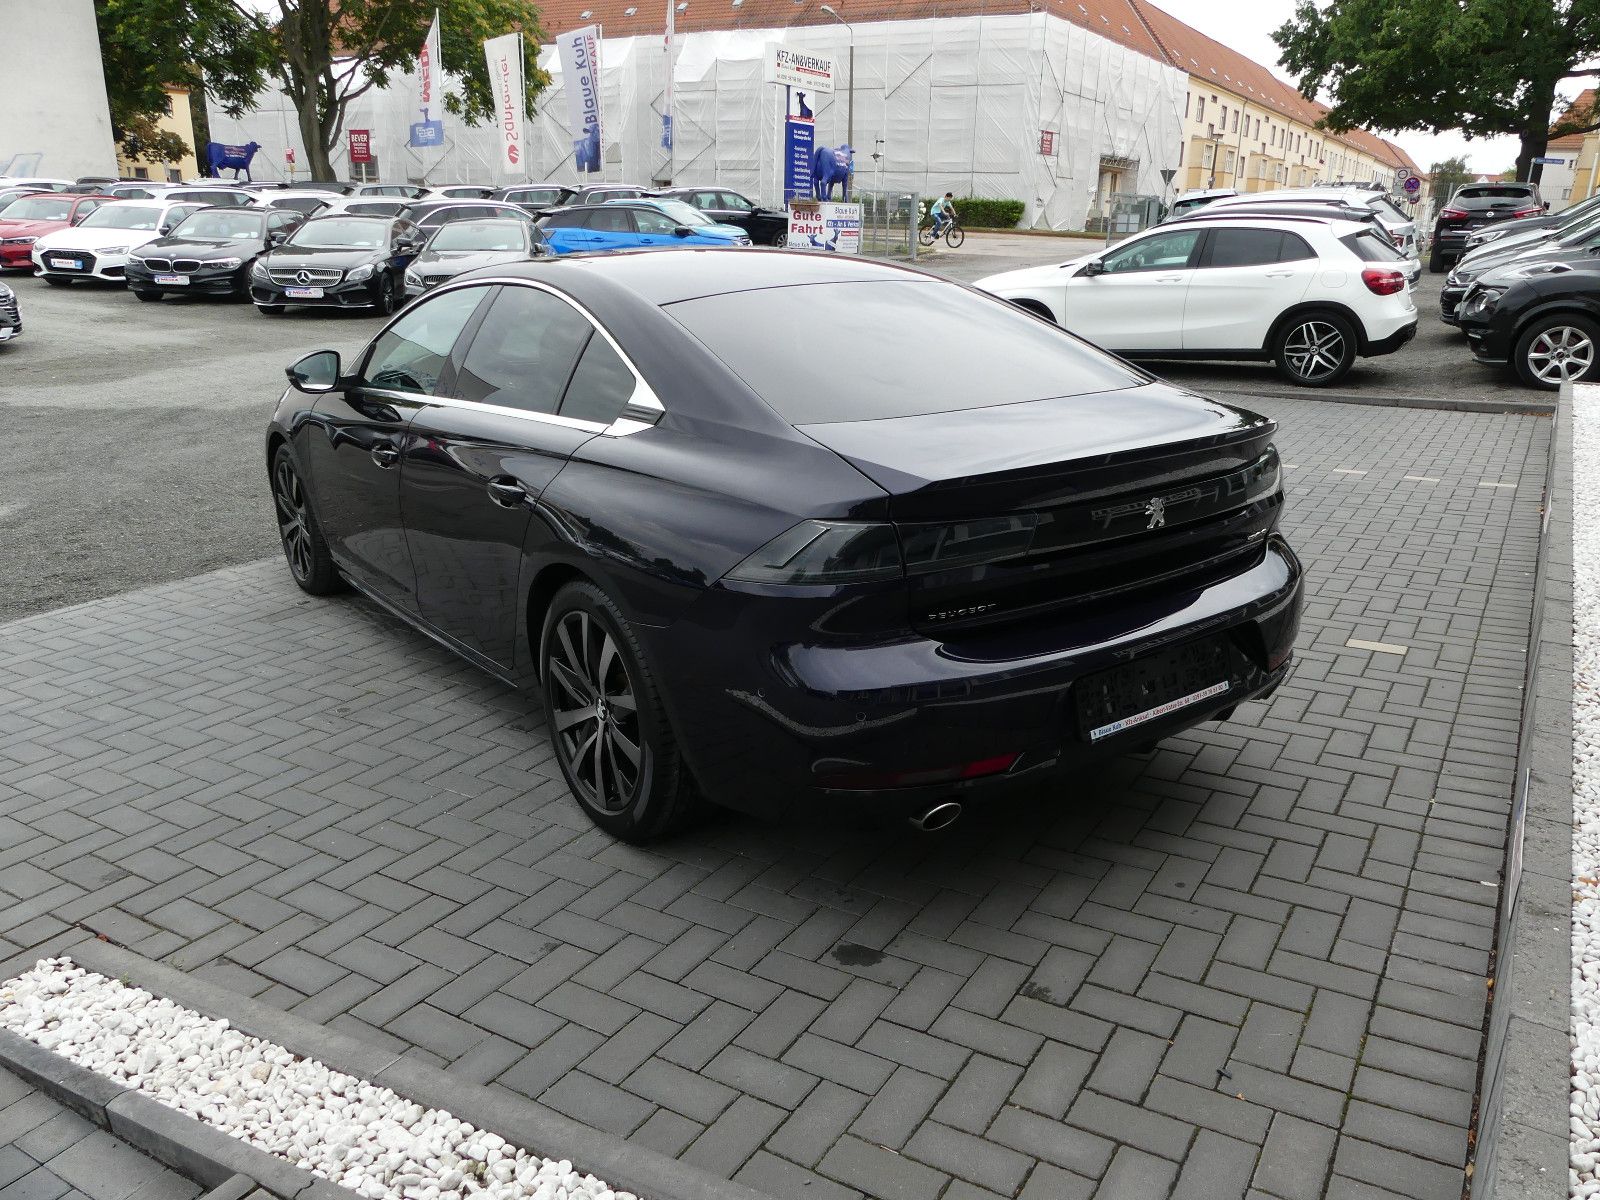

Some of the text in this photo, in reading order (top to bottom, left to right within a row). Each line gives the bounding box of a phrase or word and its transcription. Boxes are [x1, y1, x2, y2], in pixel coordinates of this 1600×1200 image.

[572, 36, 598, 124] Blaue Kuh
[793, 210, 822, 222] Gute
[791, 224, 824, 235] Fahrt
[928, 603, 997, 620] PEUGEOT
